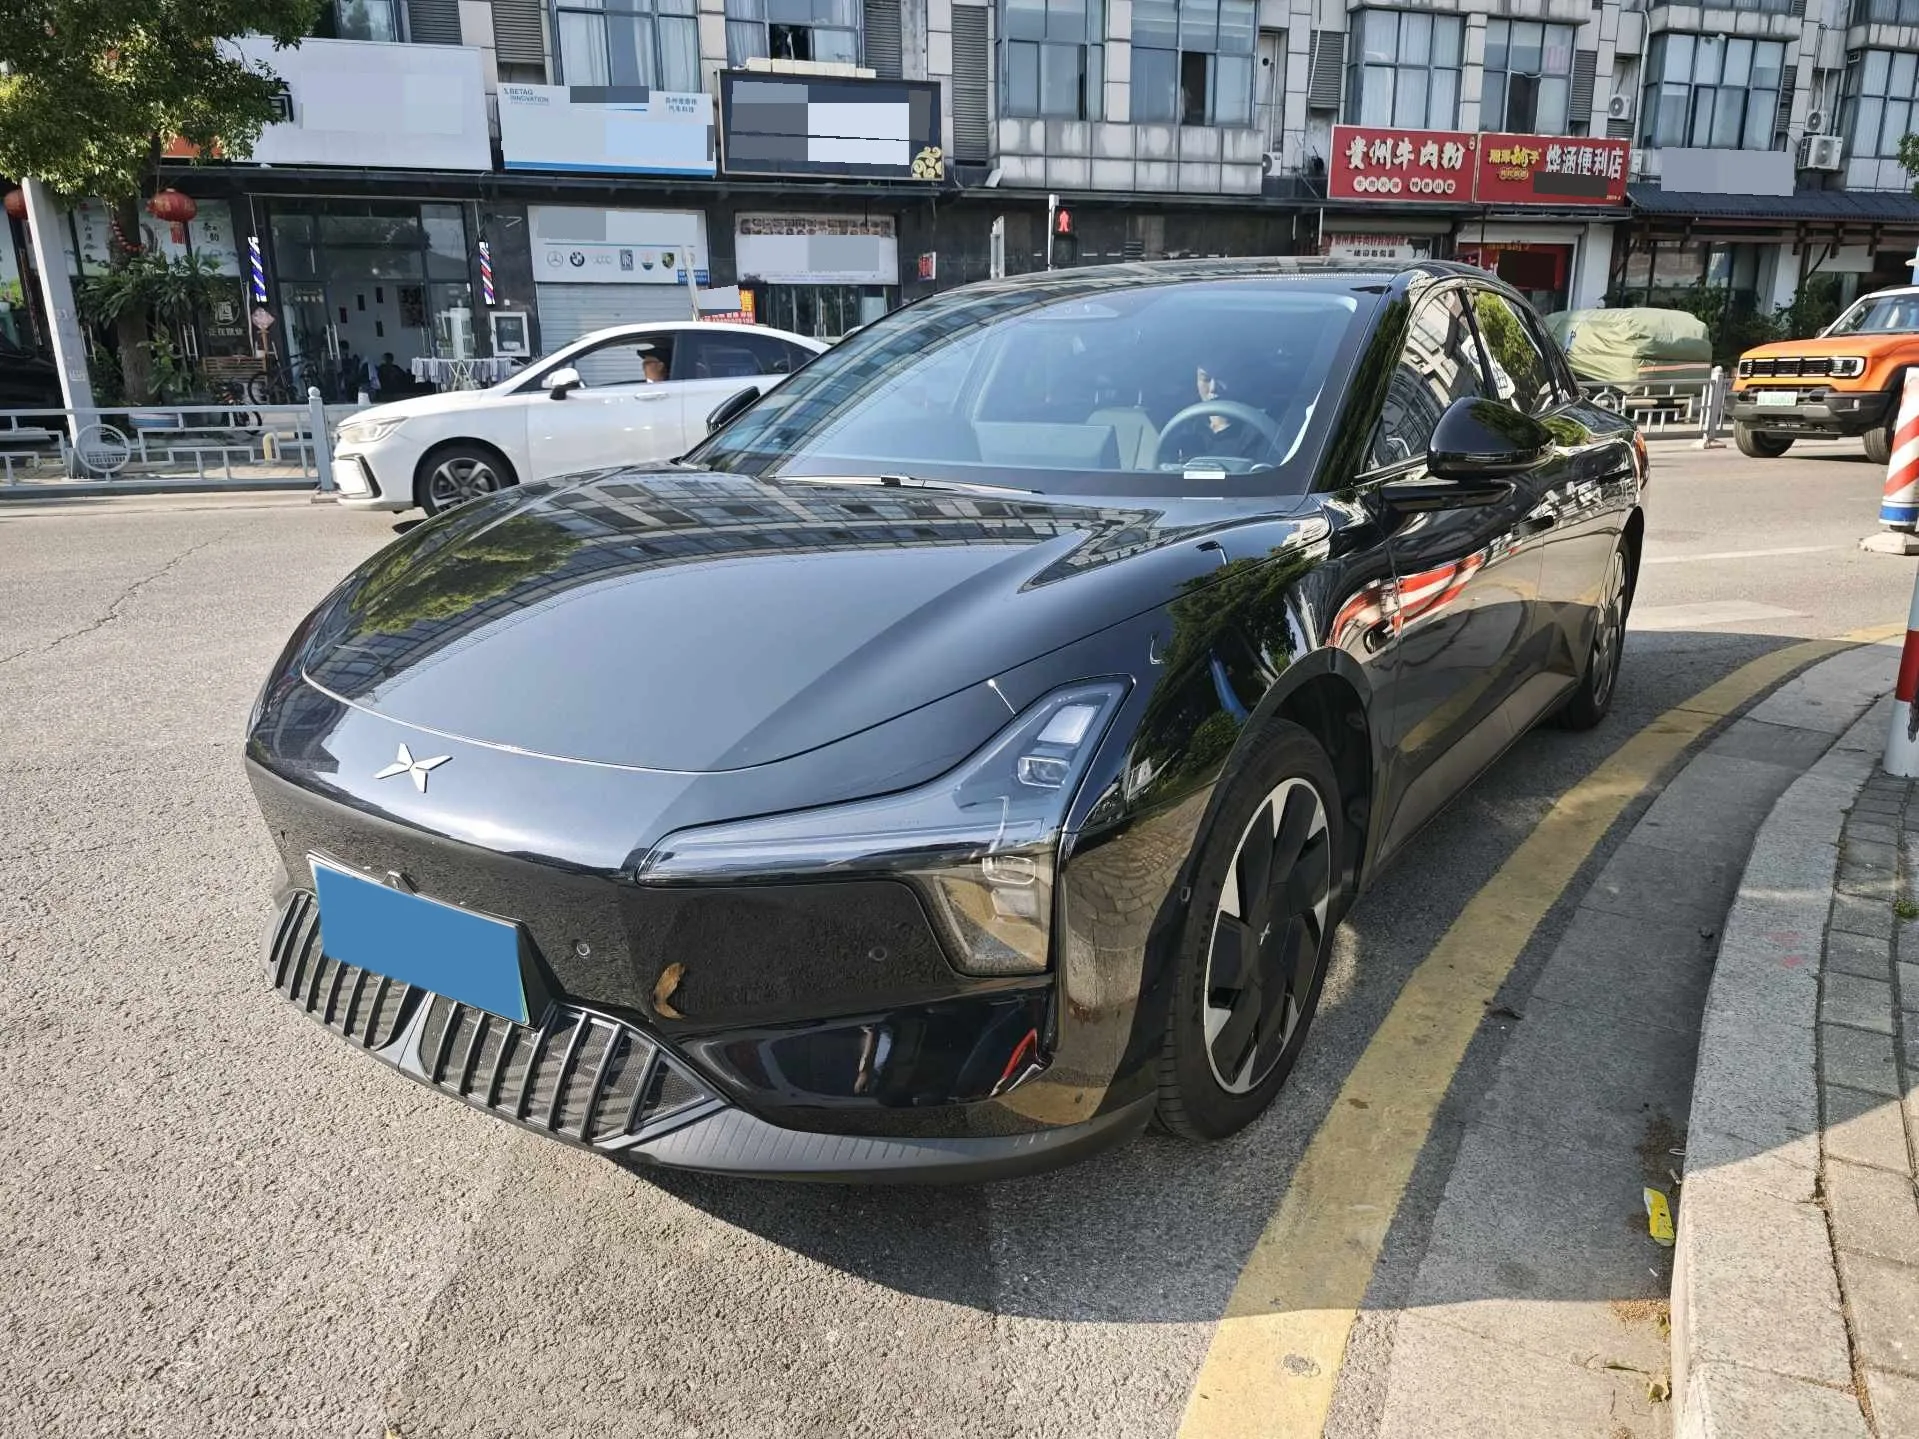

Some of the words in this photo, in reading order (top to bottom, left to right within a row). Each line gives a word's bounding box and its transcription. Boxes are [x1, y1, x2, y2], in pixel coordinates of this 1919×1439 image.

[1545, 143, 1624, 180] 烨涵便利店
